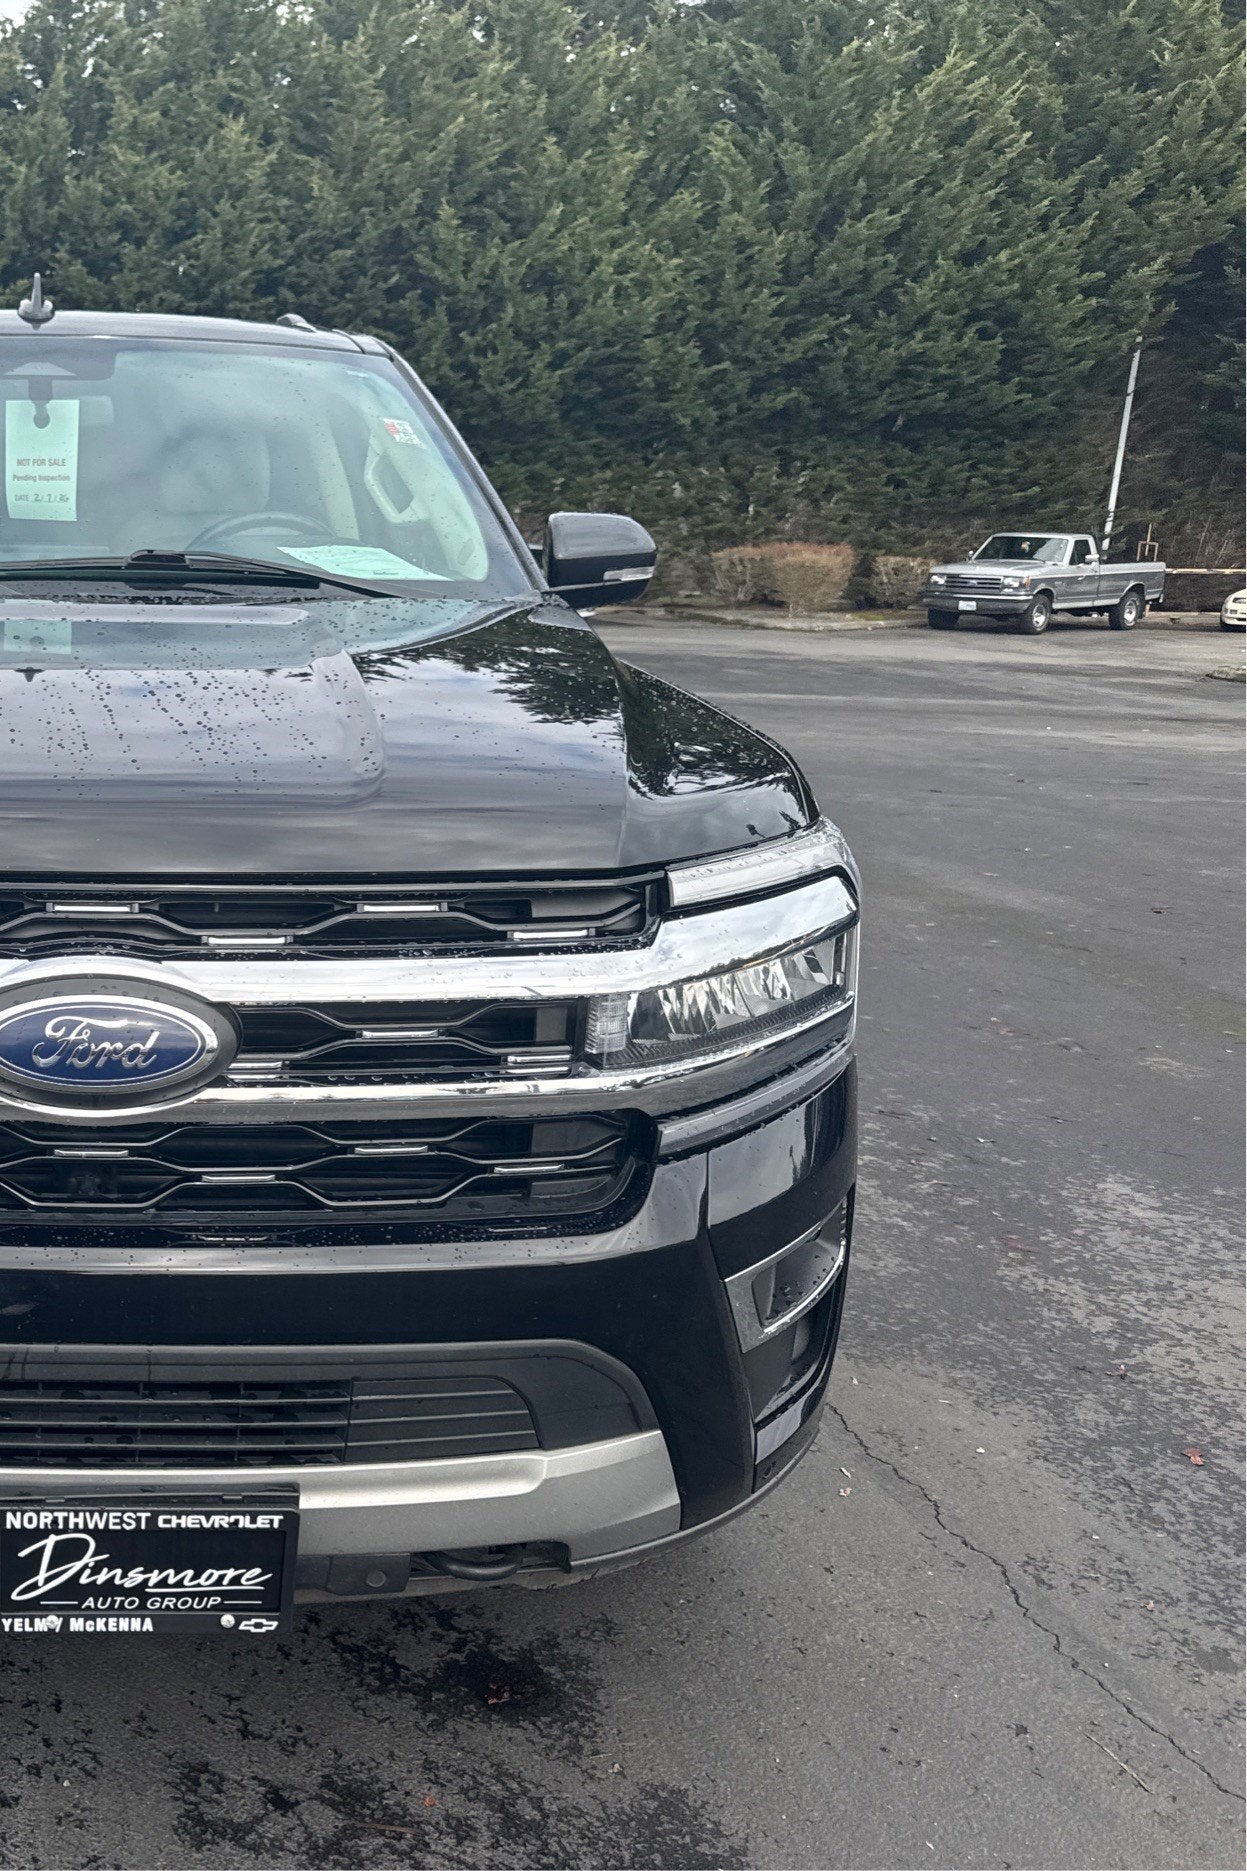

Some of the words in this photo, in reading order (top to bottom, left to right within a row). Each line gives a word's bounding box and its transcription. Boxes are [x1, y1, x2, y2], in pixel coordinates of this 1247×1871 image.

[31, 1015, 160, 1069] Ford
[5, 1511, 152, 1530] NORTHWEST
[157, 1514, 284, 1529] CHEVROLET
[10, 1533, 273, 1601] Dinsmore
[81, 1596, 140, 1610] AUTO
[146, 1596, 222, 1610] GROUP
[69, 1617, 154, 1633] McKENNA
